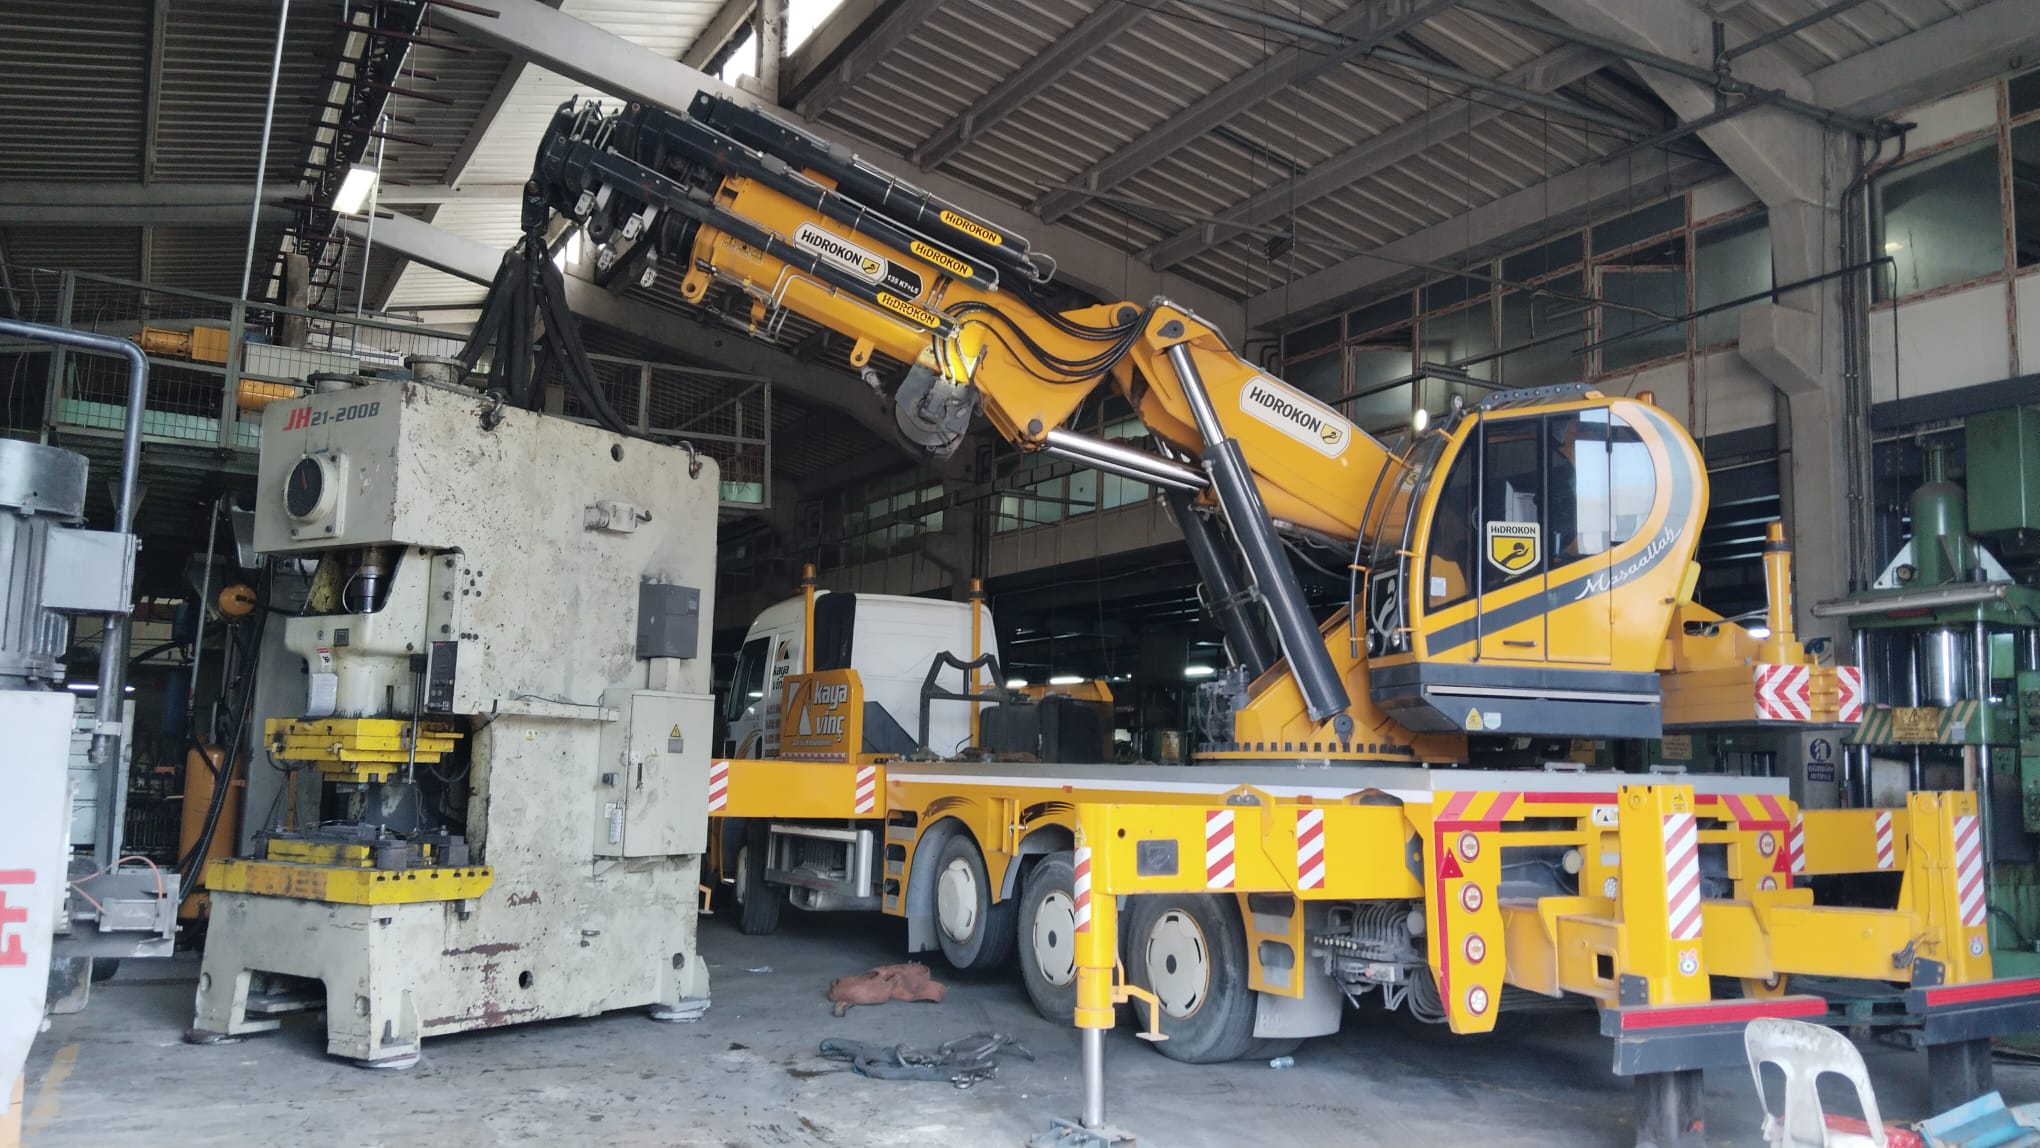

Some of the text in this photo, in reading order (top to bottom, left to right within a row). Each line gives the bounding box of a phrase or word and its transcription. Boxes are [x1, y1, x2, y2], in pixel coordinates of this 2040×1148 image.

[801, 229, 863, 266] HiDROKON
[1249, 386, 1322, 433] HiDROKON
[813, 680, 848, 710] kaya
[816, 710, 845, 742] vinç
